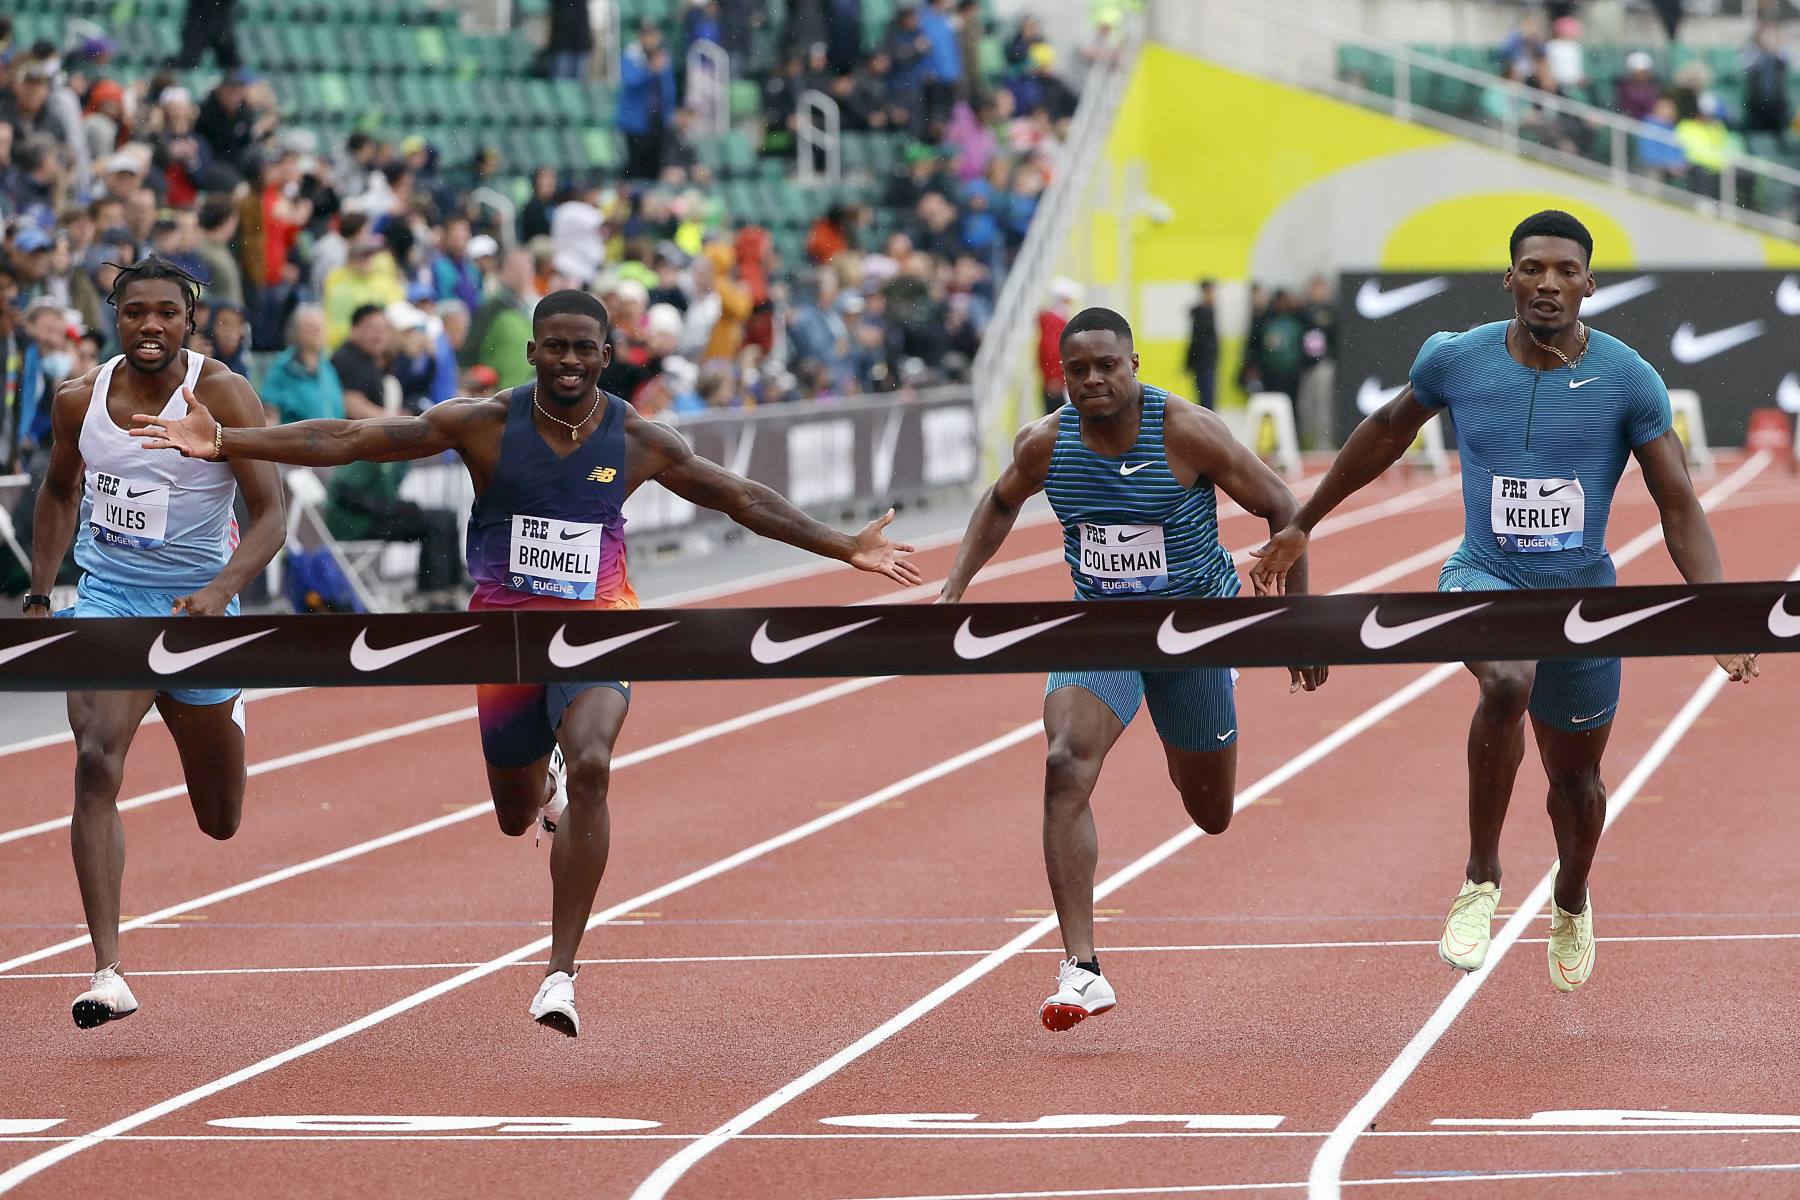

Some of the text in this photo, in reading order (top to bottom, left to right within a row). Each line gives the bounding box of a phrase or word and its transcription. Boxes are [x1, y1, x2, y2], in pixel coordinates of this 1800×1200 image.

[97, 473, 120, 496] PRE
[1501, 479, 1527, 499] PRE
[106, 502, 146, 530] LYLES
[1506, 507, 1571, 529] KERLEY
[521, 518, 549, 540] PRE
[1084, 525, 1107, 545] PRE
[106, 533, 141, 548] EUGENE
[1517, 538, 1559, 547] EUGENE
[519, 545, 591, 574] BROMELL
[1084, 548, 1161, 572] COLEMAN
[532, 580, 574, 594] EUGENE
[1101, 580, 1143, 590] EUGENE
